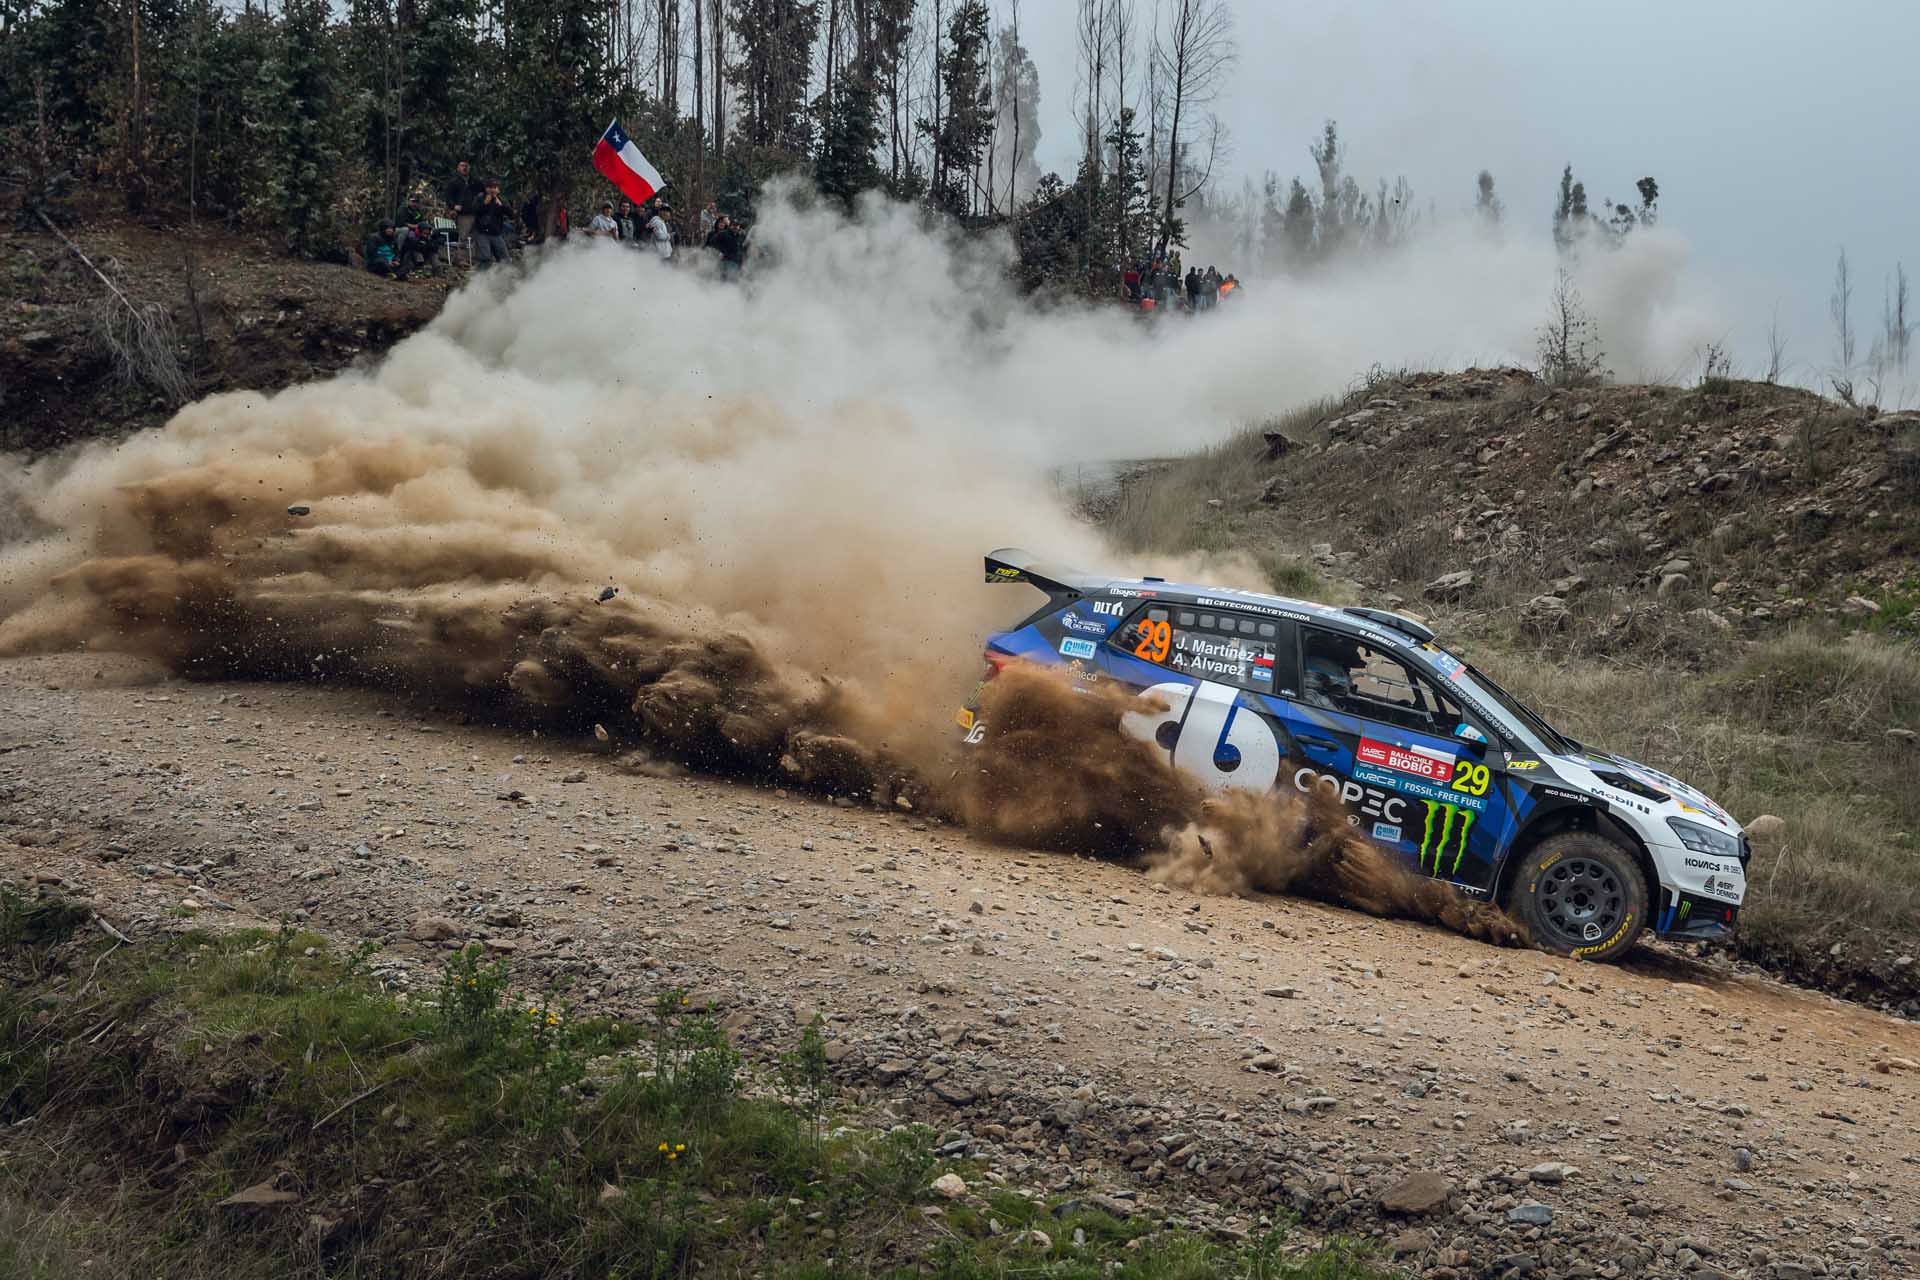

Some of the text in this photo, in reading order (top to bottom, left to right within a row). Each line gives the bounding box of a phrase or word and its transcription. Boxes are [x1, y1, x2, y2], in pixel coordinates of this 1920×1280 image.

[1093, 601, 1112, 614] DLT
[1135, 619, 1172, 663] 29
[1176, 638, 1255, 662] J. Martínez
[1172, 652, 1246, 677] A. Álvarez
[1355, 770, 1396, 786] WRC2
[1451, 761, 1490, 796] 29
[1404, 782, 1482, 809] FOSSIL-FREE FUEL
[1591, 787, 1633, 808] Mobil
[1685, 858, 1721, 872] KOVACS
[1717, 881, 1734, 890] AVERY
